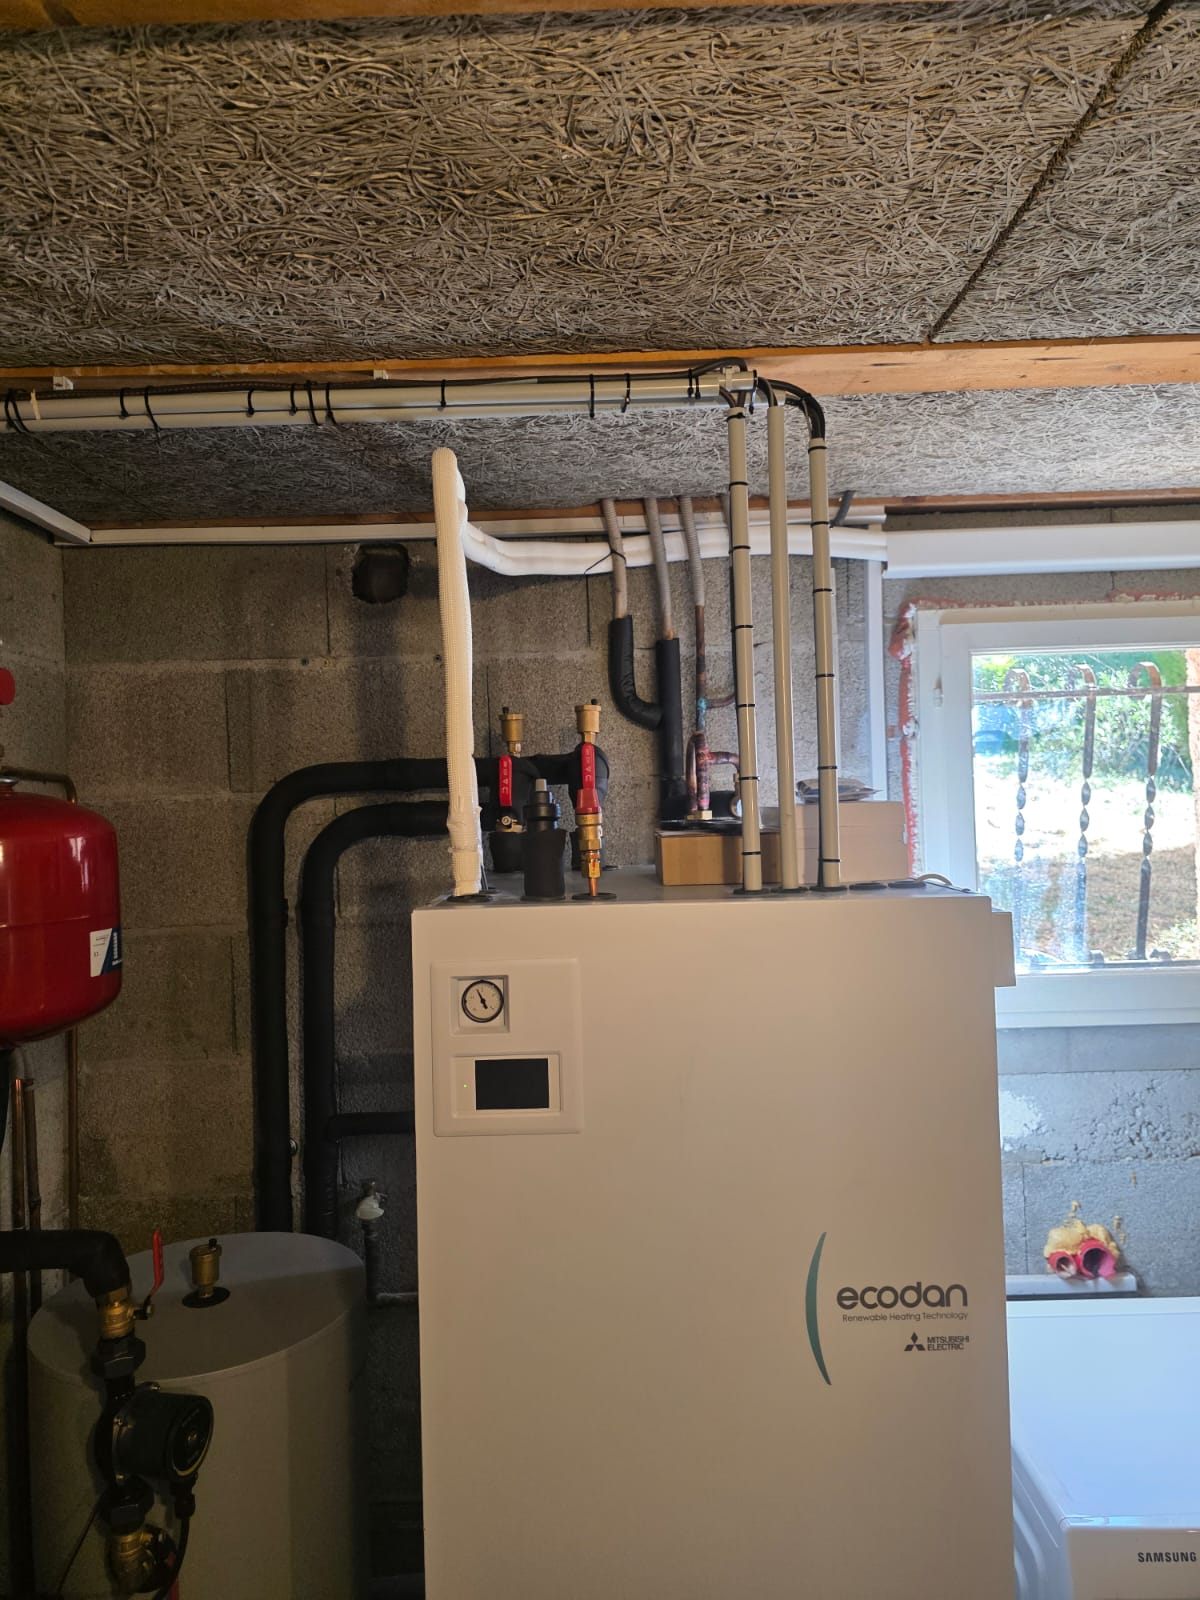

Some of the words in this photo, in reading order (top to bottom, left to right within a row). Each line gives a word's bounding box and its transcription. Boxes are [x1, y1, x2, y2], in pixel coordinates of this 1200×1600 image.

[836, 1281, 968, 1310] ecodan
[842, 1313, 887, 1322] Renewable
[889, 1312, 921, 1322] Heating
[922, 1311, 968, 1321] Technology
[927, 1335, 969, 1343] MITSUBISHI
[927, 1343, 964, 1351] ELECTRIC
[1137, 1551, 1197, 1563] SAMSUNG
